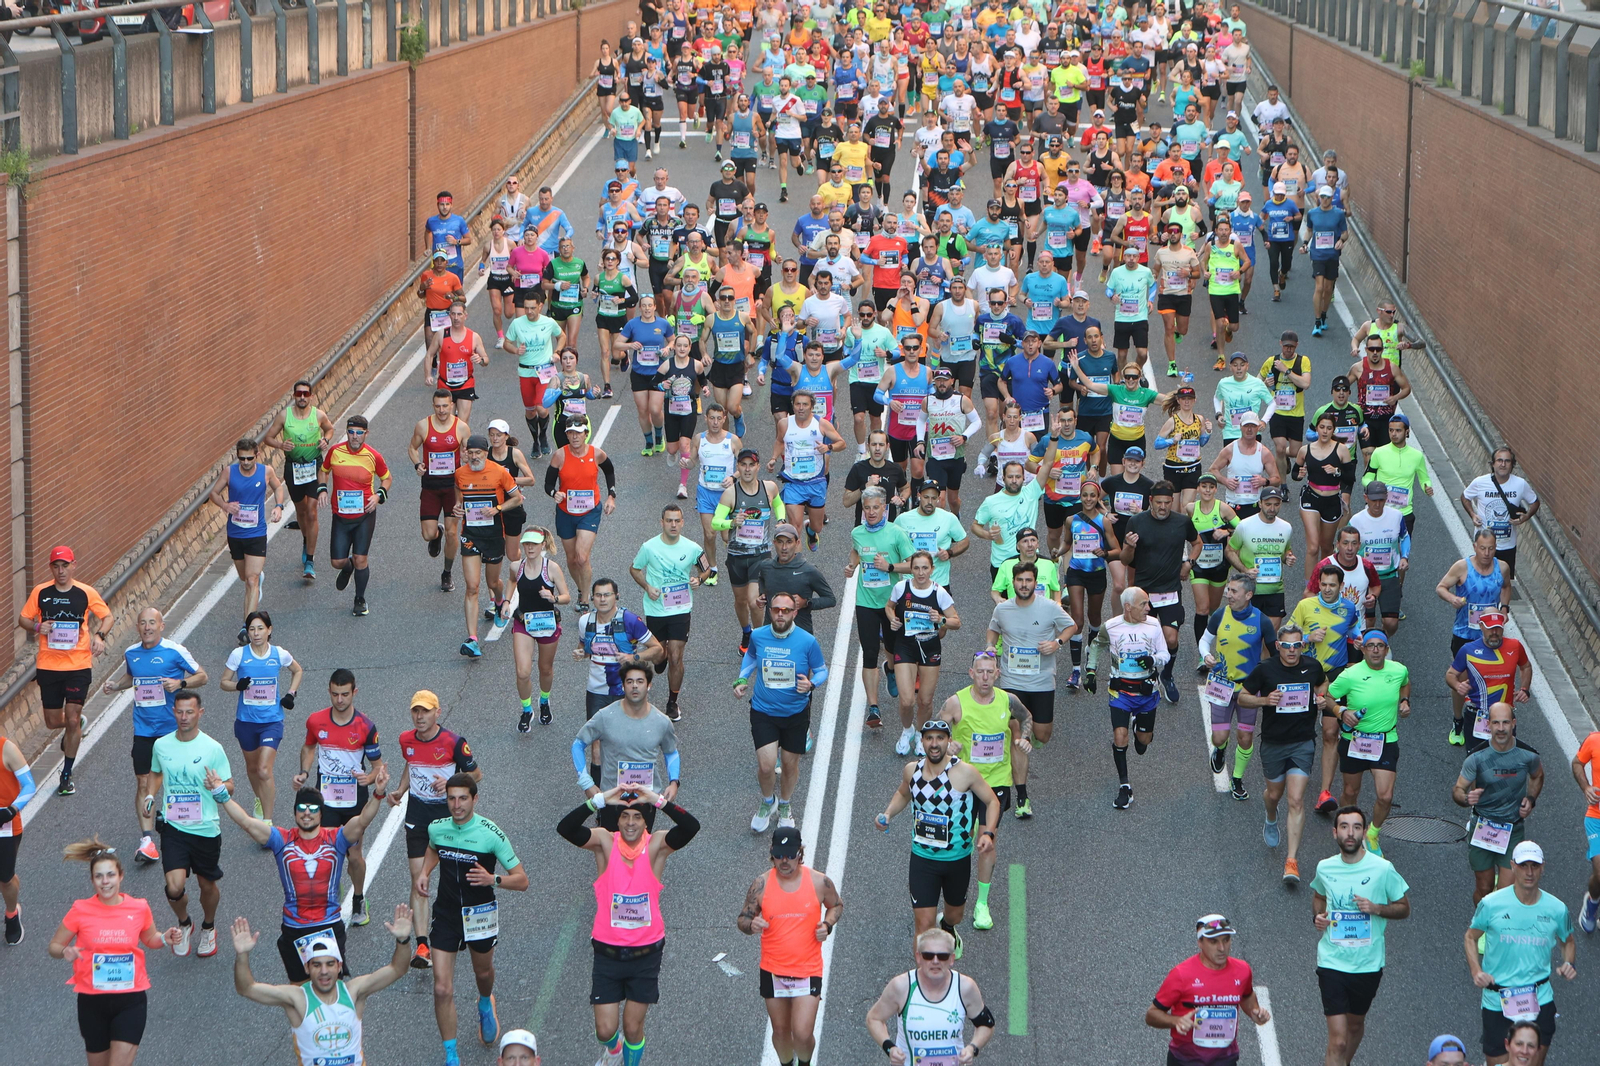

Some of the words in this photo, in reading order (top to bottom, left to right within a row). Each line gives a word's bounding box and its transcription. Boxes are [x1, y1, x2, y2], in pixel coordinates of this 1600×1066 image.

[1128, 634, 1139, 642] XL
[439, 850, 478, 860] ORBEA
[1194, 995, 1210, 1003] Los
[910, 1030, 949, 1040] TOGHER
